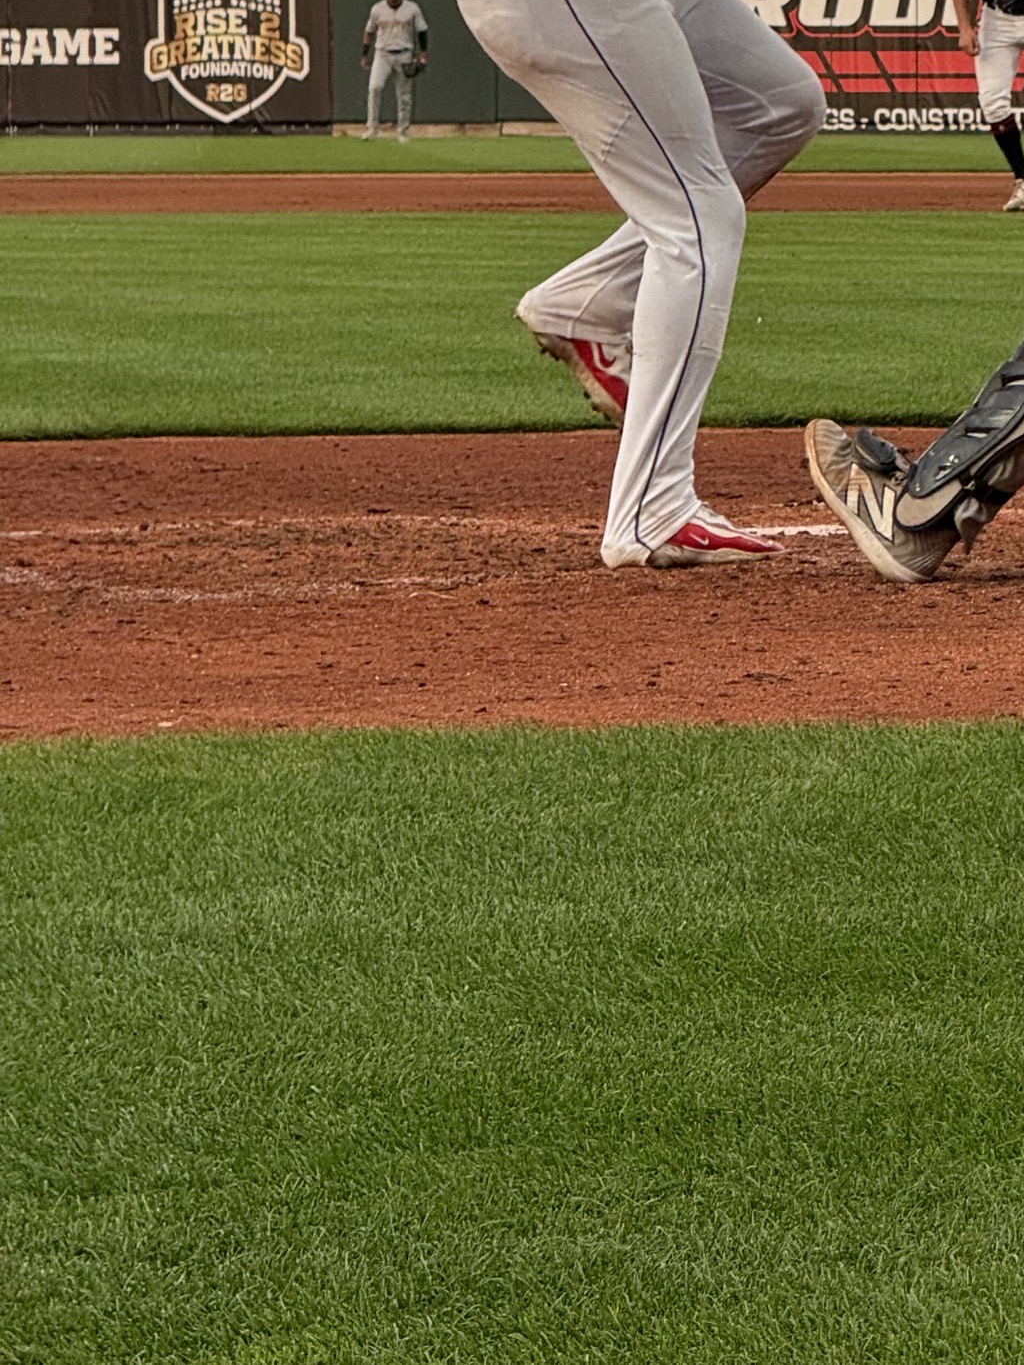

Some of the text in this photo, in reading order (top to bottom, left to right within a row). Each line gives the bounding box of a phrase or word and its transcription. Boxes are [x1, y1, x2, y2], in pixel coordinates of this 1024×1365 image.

[173, 7, 281, 40] RISE 2
[0, 27, 120, 66] GAME
[150, 33, 304, 72] GREATNESS
[180, 62, 275, 81] FOUNDATION
[205, 83, 248, 103] R2G
[846, 462, 897, 544] N
